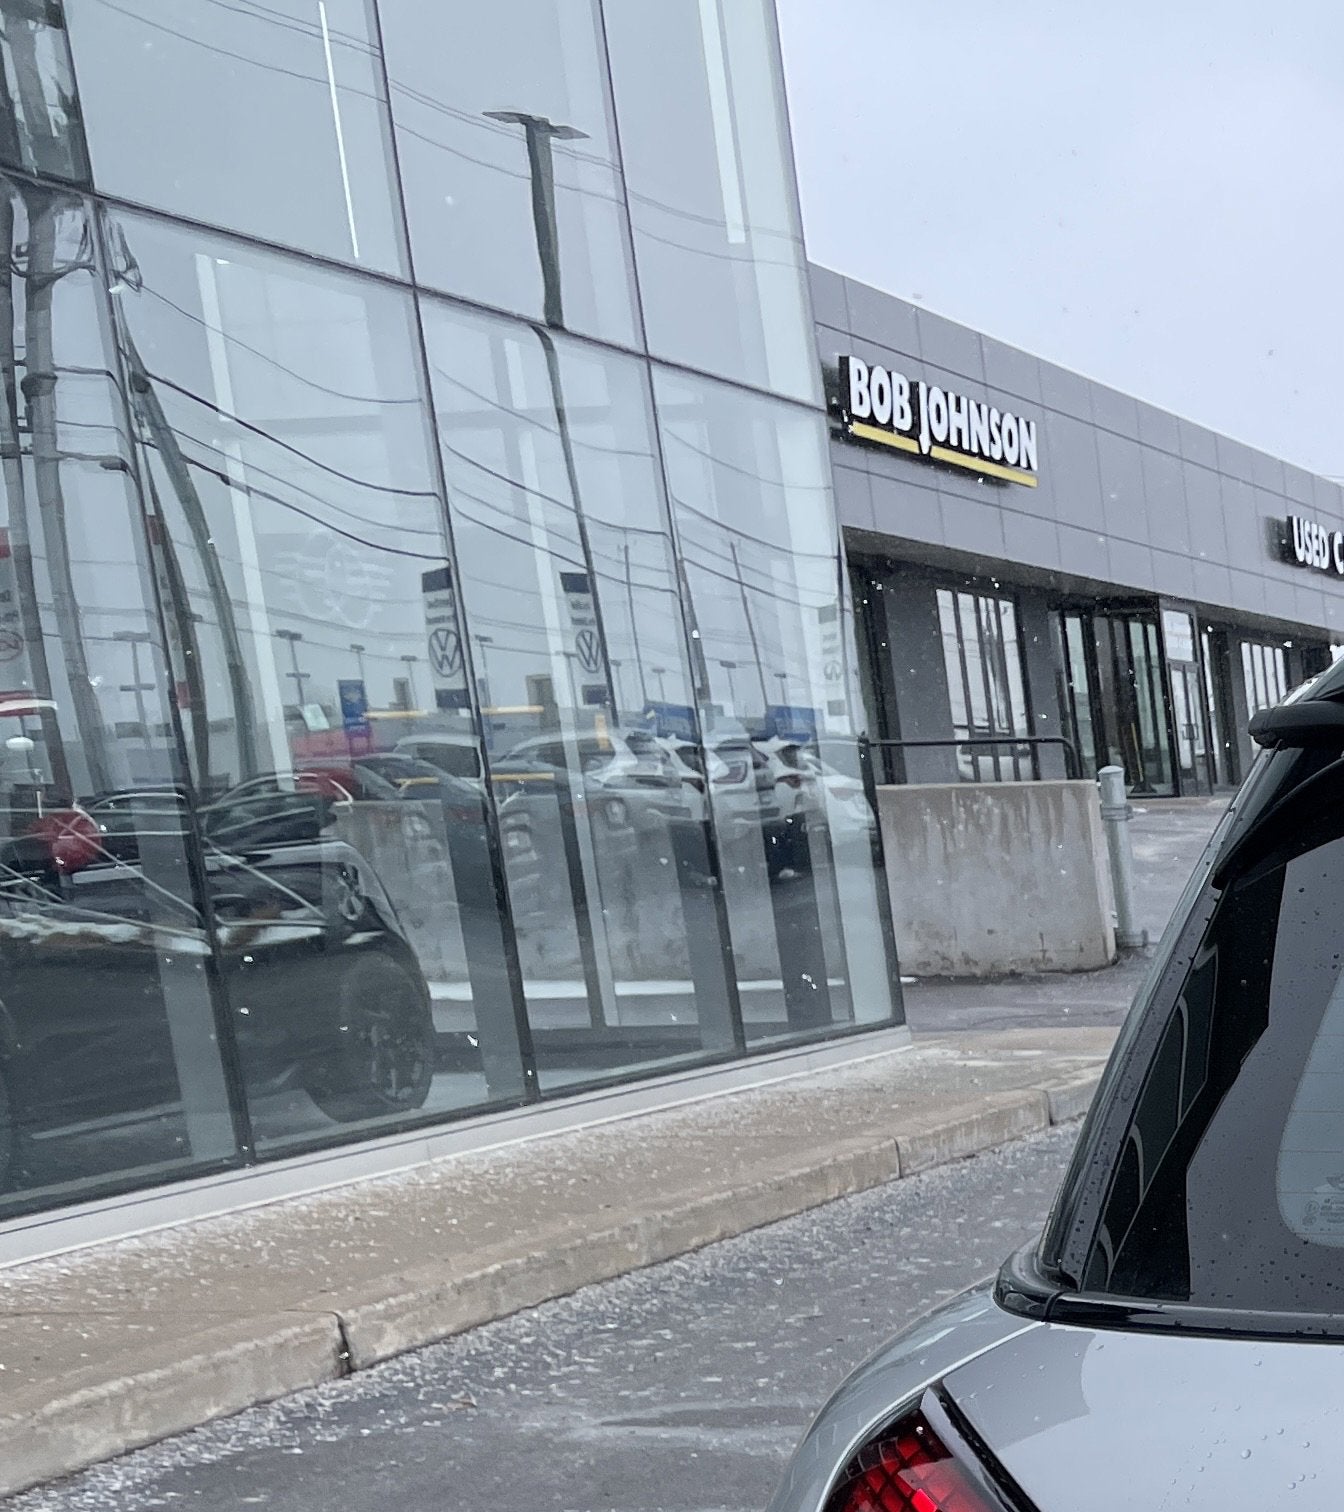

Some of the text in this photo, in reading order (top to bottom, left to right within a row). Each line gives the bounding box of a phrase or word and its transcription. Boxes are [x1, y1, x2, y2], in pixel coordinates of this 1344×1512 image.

[849, 355, 1039, 472] BOB JOHNSON
[1292, 515, 1330, 570] USED
